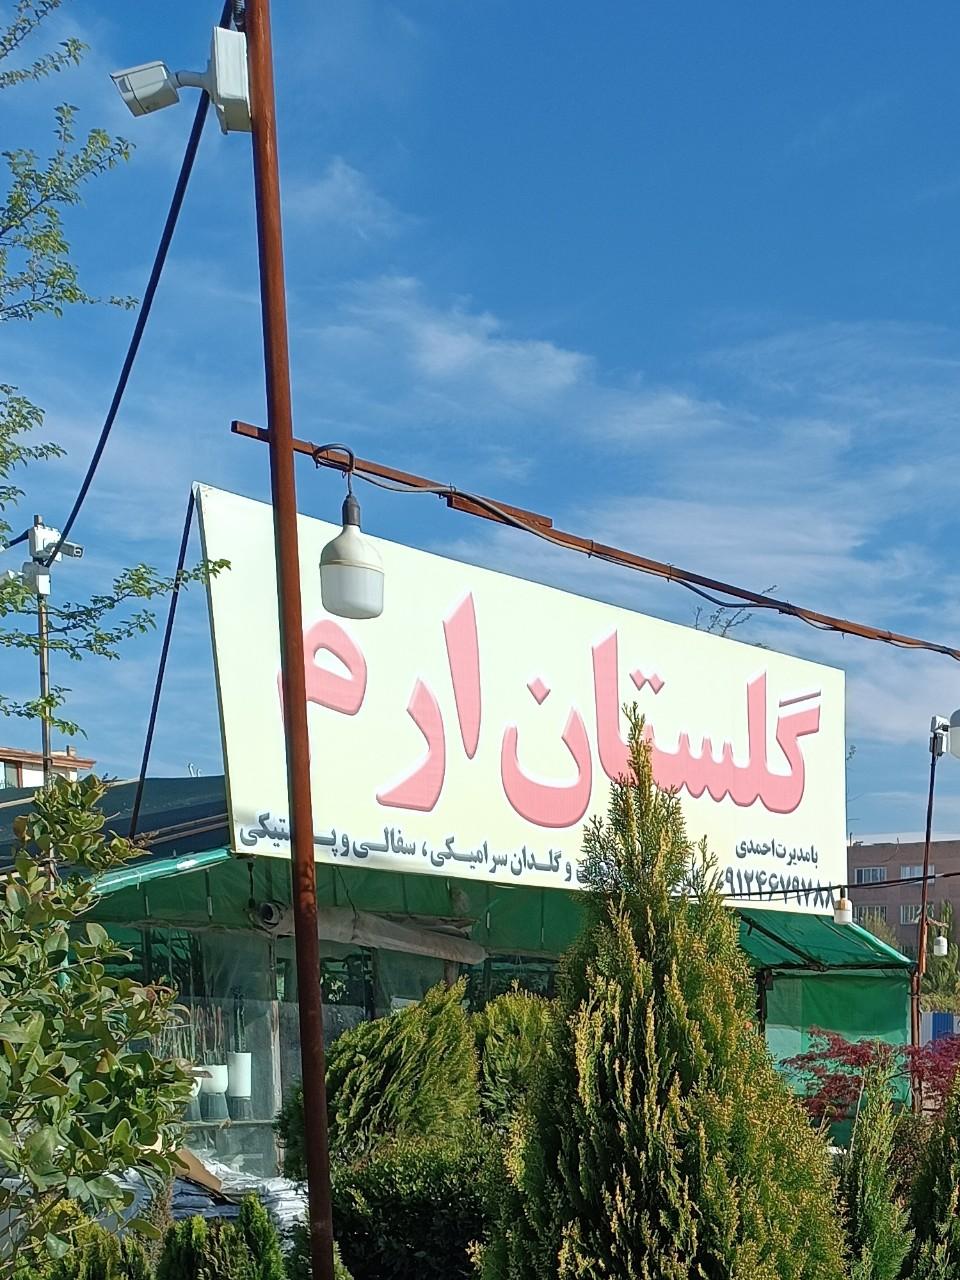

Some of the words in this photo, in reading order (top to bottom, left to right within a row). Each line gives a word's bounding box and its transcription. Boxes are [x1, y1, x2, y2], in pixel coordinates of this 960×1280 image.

[277, 591, 482, 813] ارم
[501, 629, 821, 828] گلستان
[239, 811, 338, 858] پتیکی
[339, 833, 350, 857] و
[353, 826, 416, 858] سفالی
[510, 845, 562, 876] گلدان
